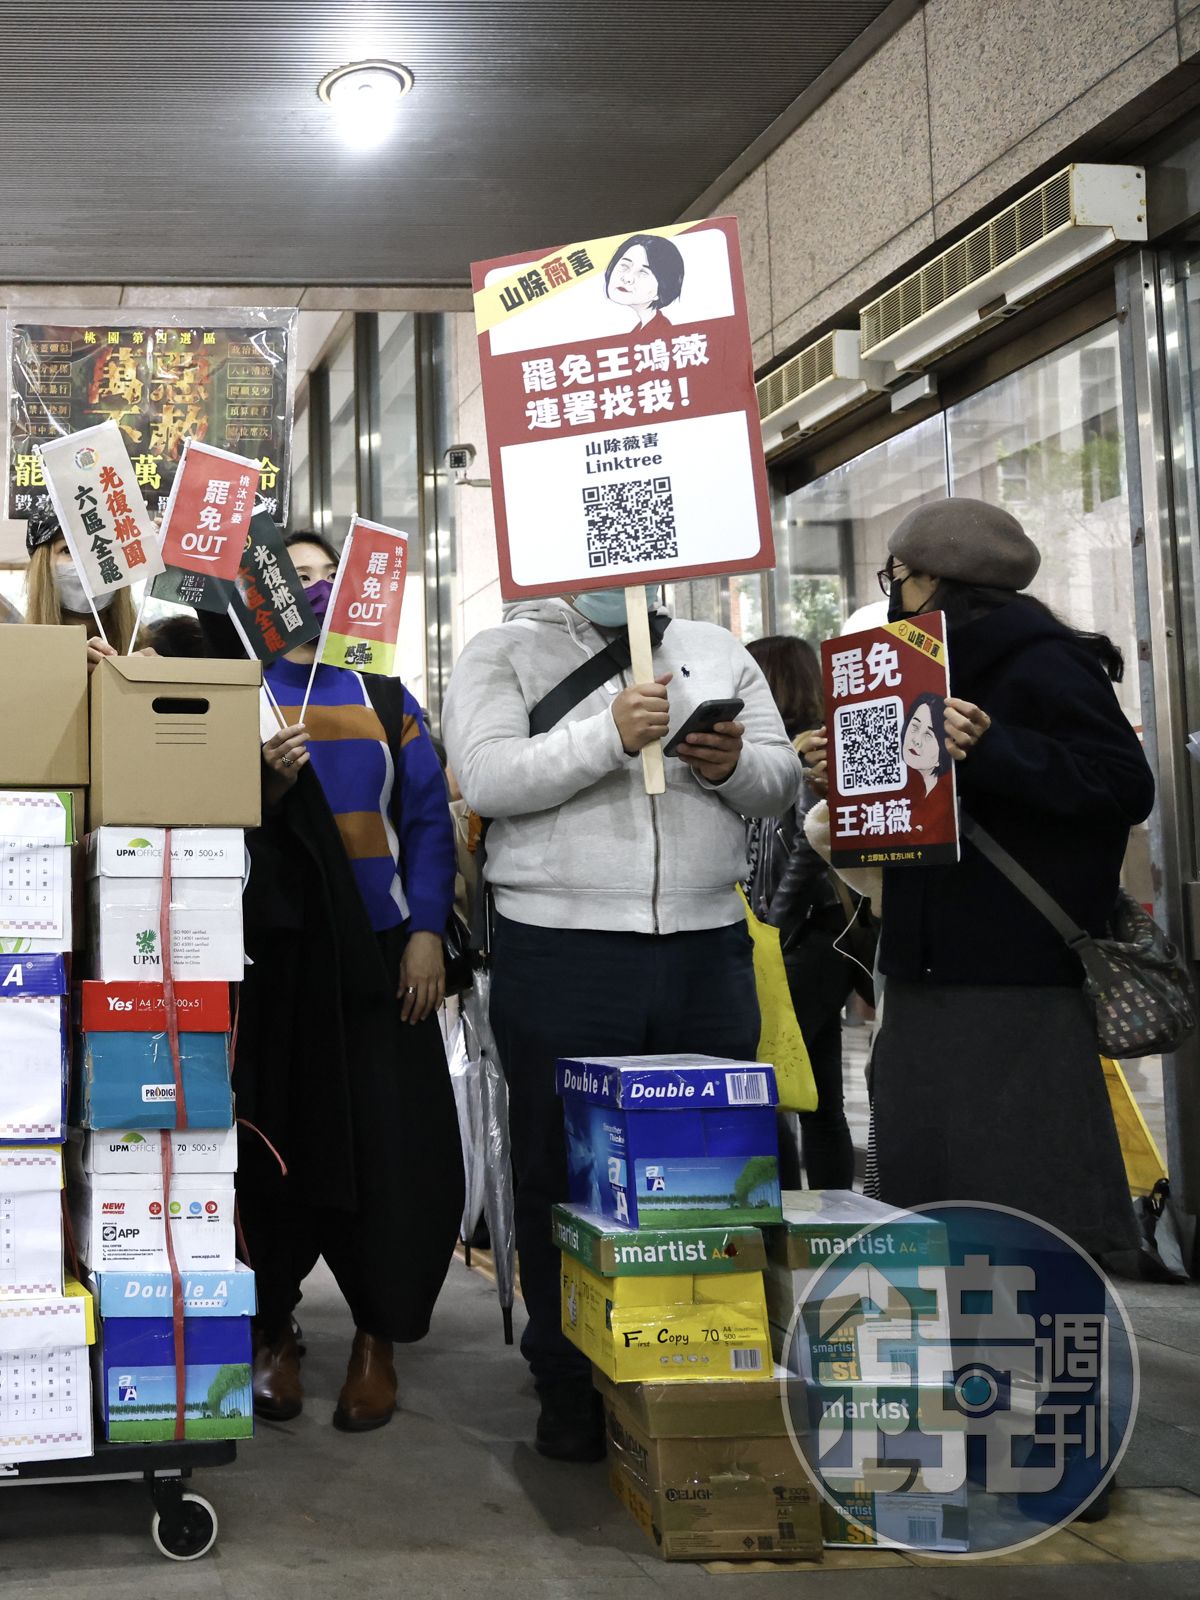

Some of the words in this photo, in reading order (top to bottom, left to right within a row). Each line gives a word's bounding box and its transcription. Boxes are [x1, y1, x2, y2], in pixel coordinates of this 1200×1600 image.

[500, 248, 595, 312] 山除薇害
[84, 331, 217, 345] 桃園第四選區
[521, 333, 710, 395] 罷免王鴻薇
[585, 432, 659, 457] 山除薇害
[586, 452, 663, 475] Linktree
[197, 479, 230, 532] 罷免
[230, 474, 250, 525] 桃汰立委
[99, 465, 147, 570] 光復桃園
[74, 485, 124, 585] 六區全罷
[181, 533, 227, 555] OUT
[360, 552, 389, 600] 罷免
[389, 546, 404, 592] 桃汰立委
[253, 545, 304, 633] 光復桃園
[348, 602, 387, 621] OUT
[831, 642, 902, 699] 罷免
[836, 798, 912, 838] 王鴻薇
[116, 849, 136, 857] UPM
[183, 849, 194, 857] 70
[133, 955, 160, 965] UPM
[2, 964, 24, 986] A
[107, 997, 133, 1011] Yes
[139, 999, 151, 1007] A4
[564, 1069, 598, 1094] Double
[601, 1077, 609, 1096] A
[630, 1082, 695, 1098] Double
[701, 1082, 715, 1097] A
[109, 1144, 129, 1152] UPM
[177, 1144, 187, 1152] 70
[118, 1229, 140, 1238] APP
[805, 1234, 896, 1255] martist
[899, 1241, 917, 1254] A4
[124, 1281, 205, 1298] Doule
[213, 1280, 228, 1297] A
[657, 1329, 689, 1346] Copy
[701, 1329, 720, 1342] 70
[812, 1342, 856, 1354] smartist
[822, 1398, 910, 1420] martist
